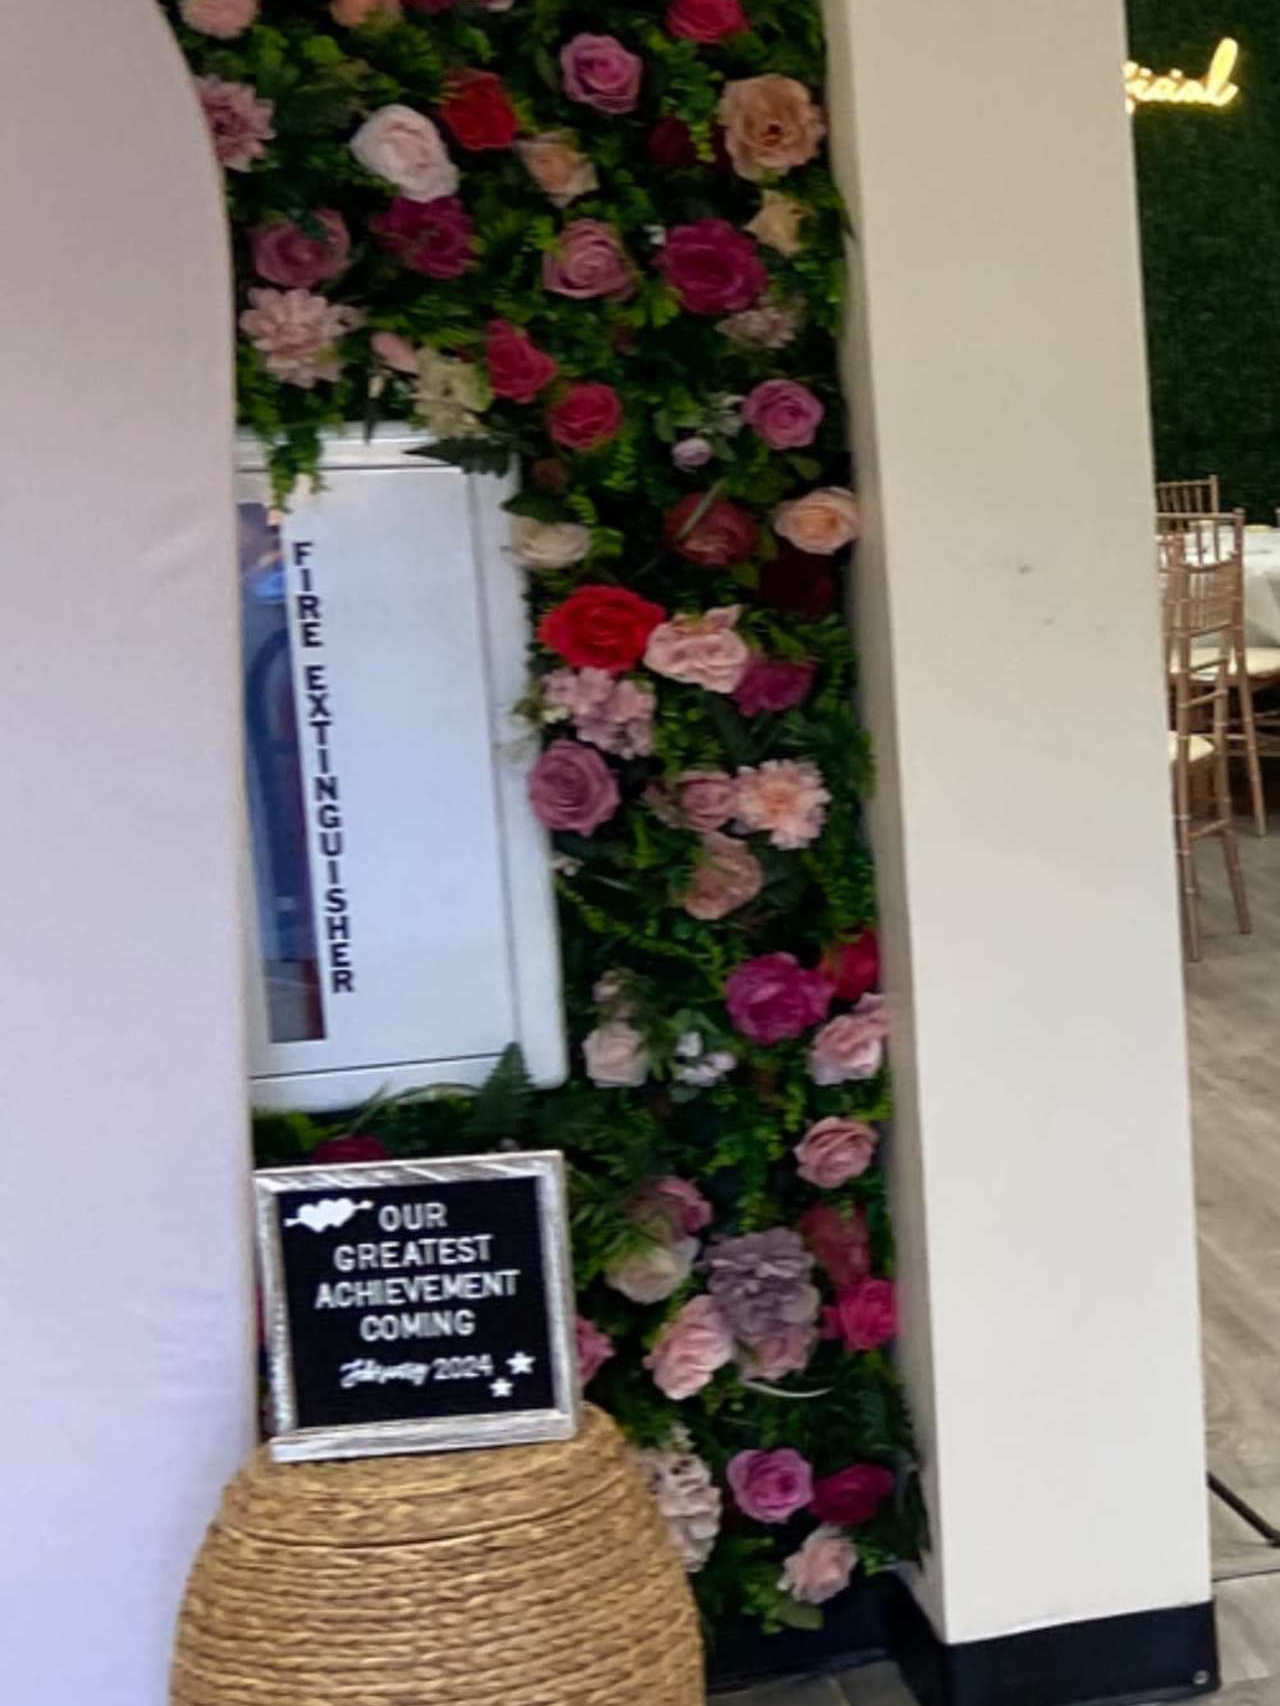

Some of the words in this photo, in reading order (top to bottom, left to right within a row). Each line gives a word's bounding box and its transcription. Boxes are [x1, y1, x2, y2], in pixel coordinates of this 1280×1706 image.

[292, 541, 324, 648] FIRE
[304, 664, 355, 994] EXTINGUISHER
[378, 1202, 448, 1231] OUR
[333, 1233, 493, 1272] GREATEST
[314, 1269, 521, 1309] ACHIEVEMENT
[360, 1309, 476, 1341] COMING
[433, 1354, 494, 1380] 2024
